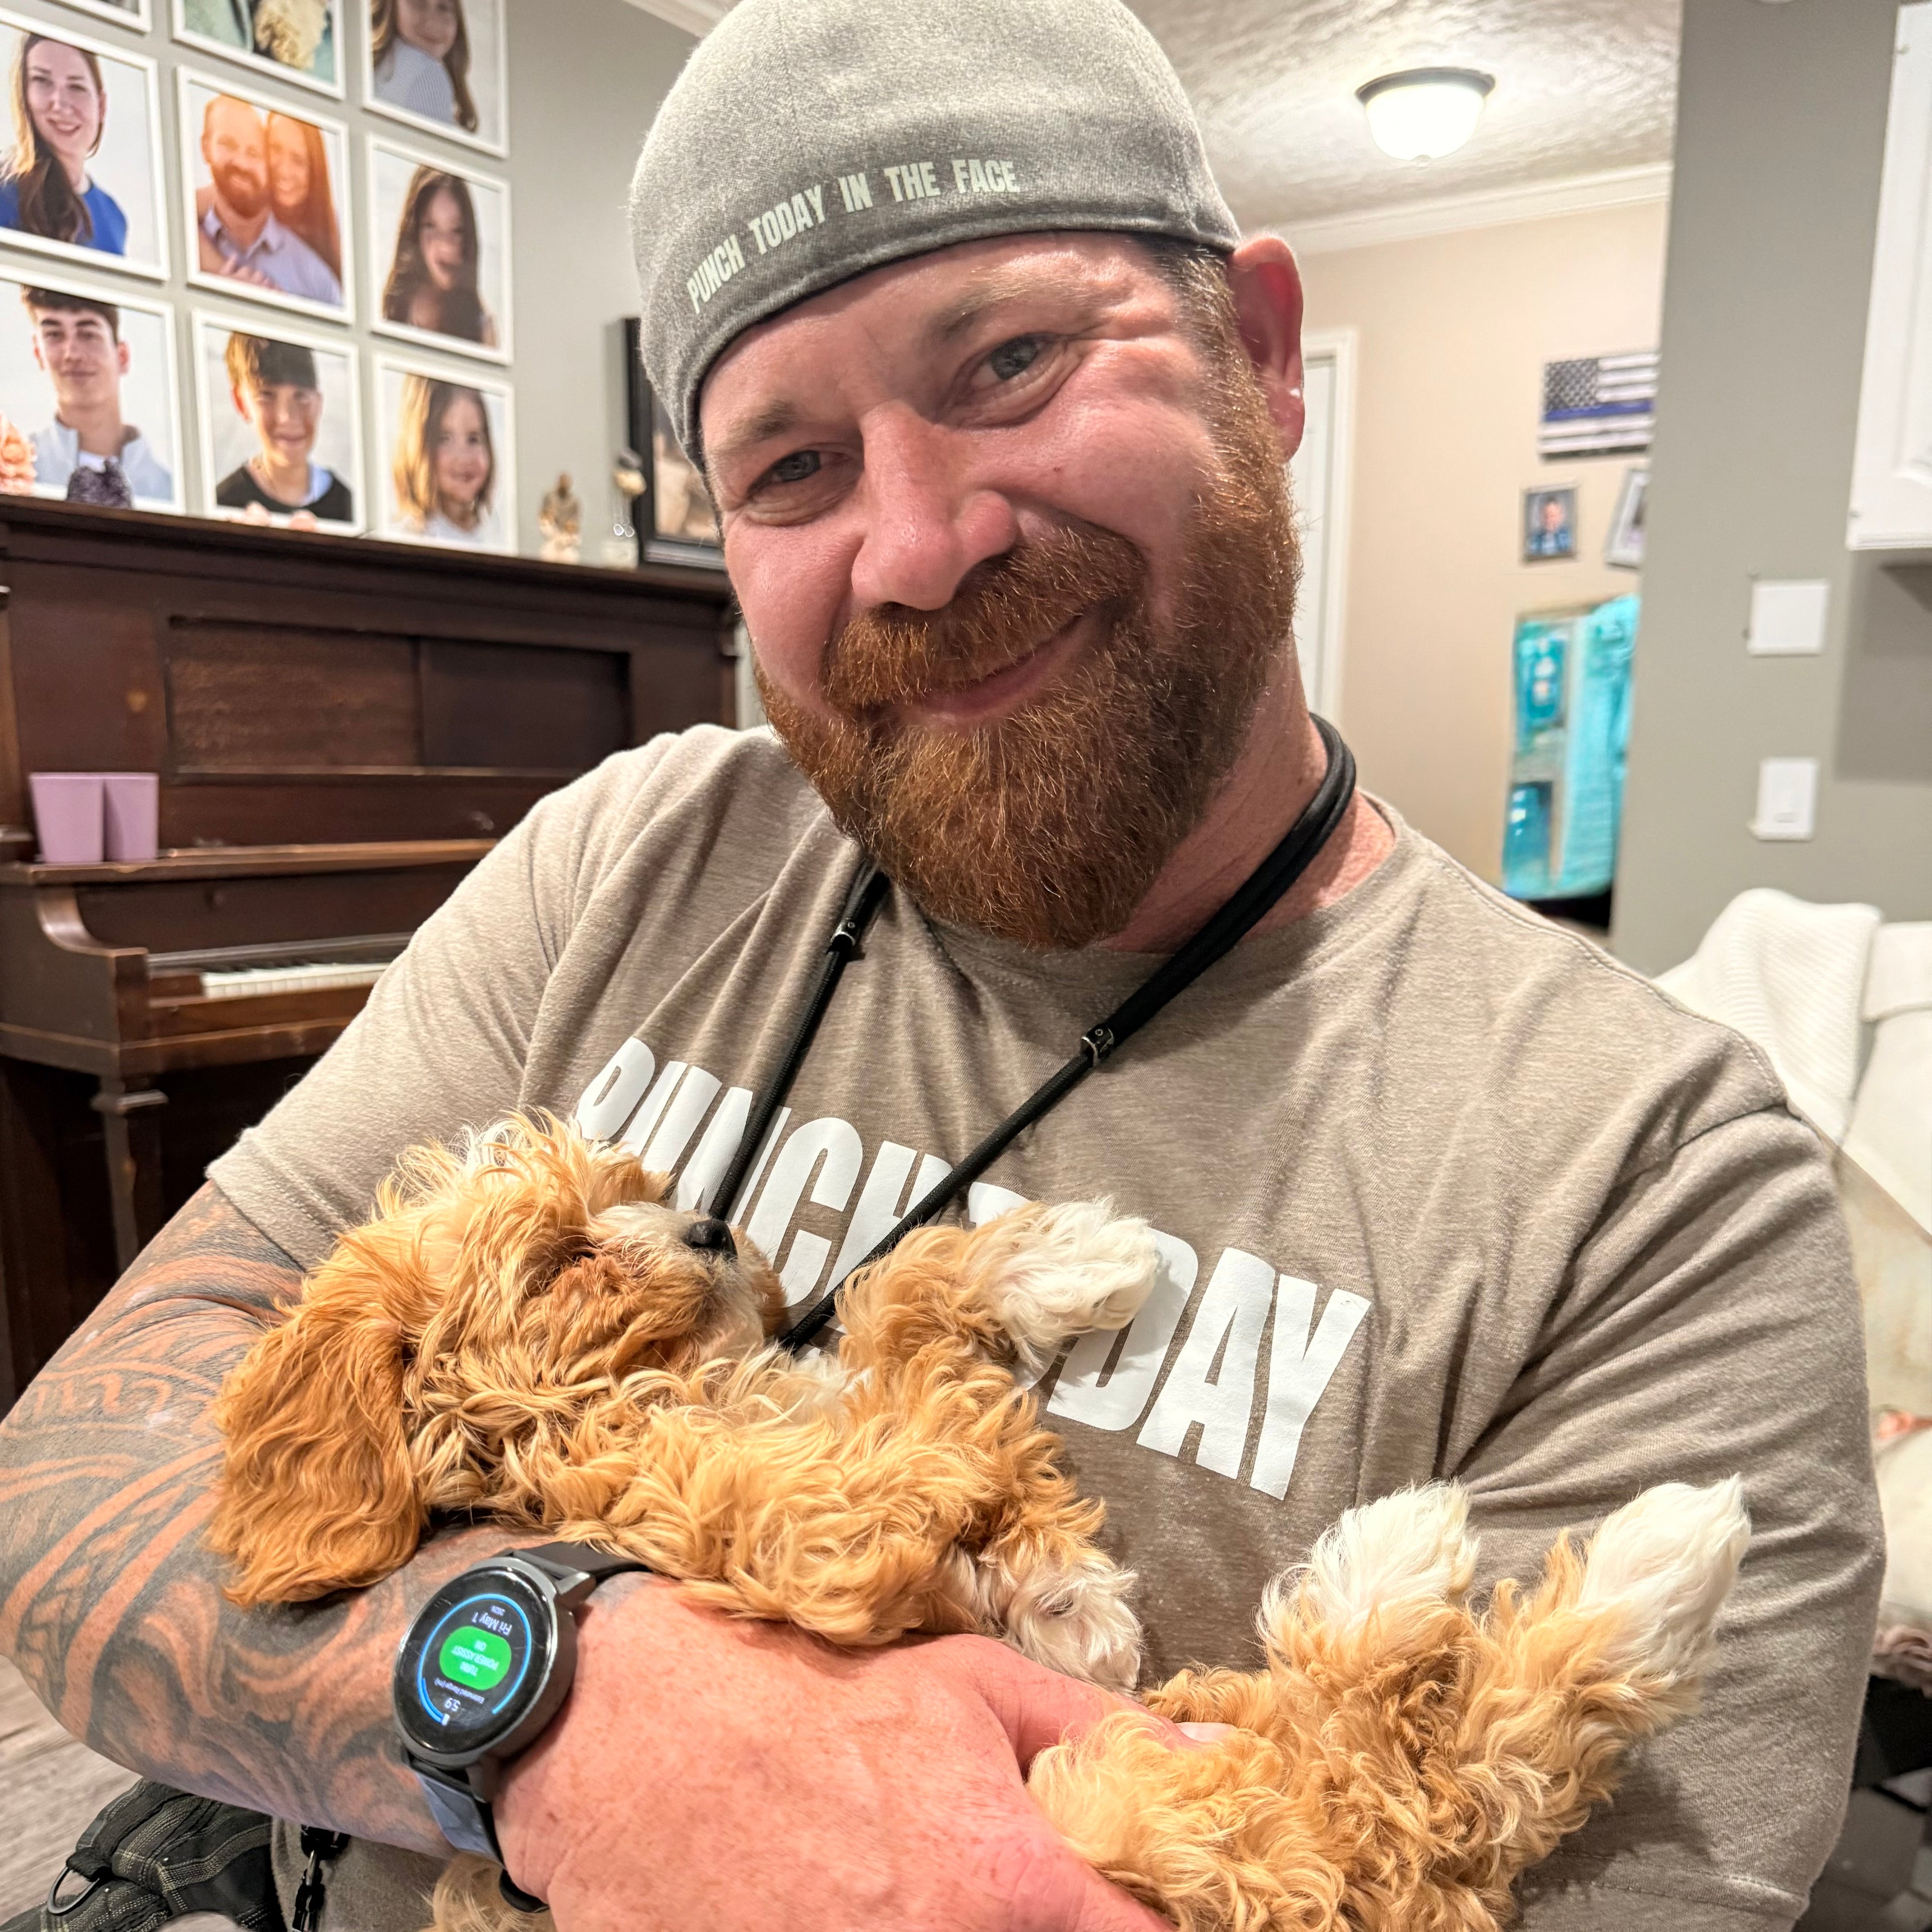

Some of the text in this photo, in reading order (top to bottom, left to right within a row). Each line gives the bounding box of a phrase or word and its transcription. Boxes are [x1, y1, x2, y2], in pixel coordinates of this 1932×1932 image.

[686, 159, 1021, 315] PUNCH TODAY IN THE FACE
[968, 1181, 1371, 1502] DAY
[451, 1645, 499, 1671] POWER ASSIST
[471, 1612, 512, 1636] Fri May 1
